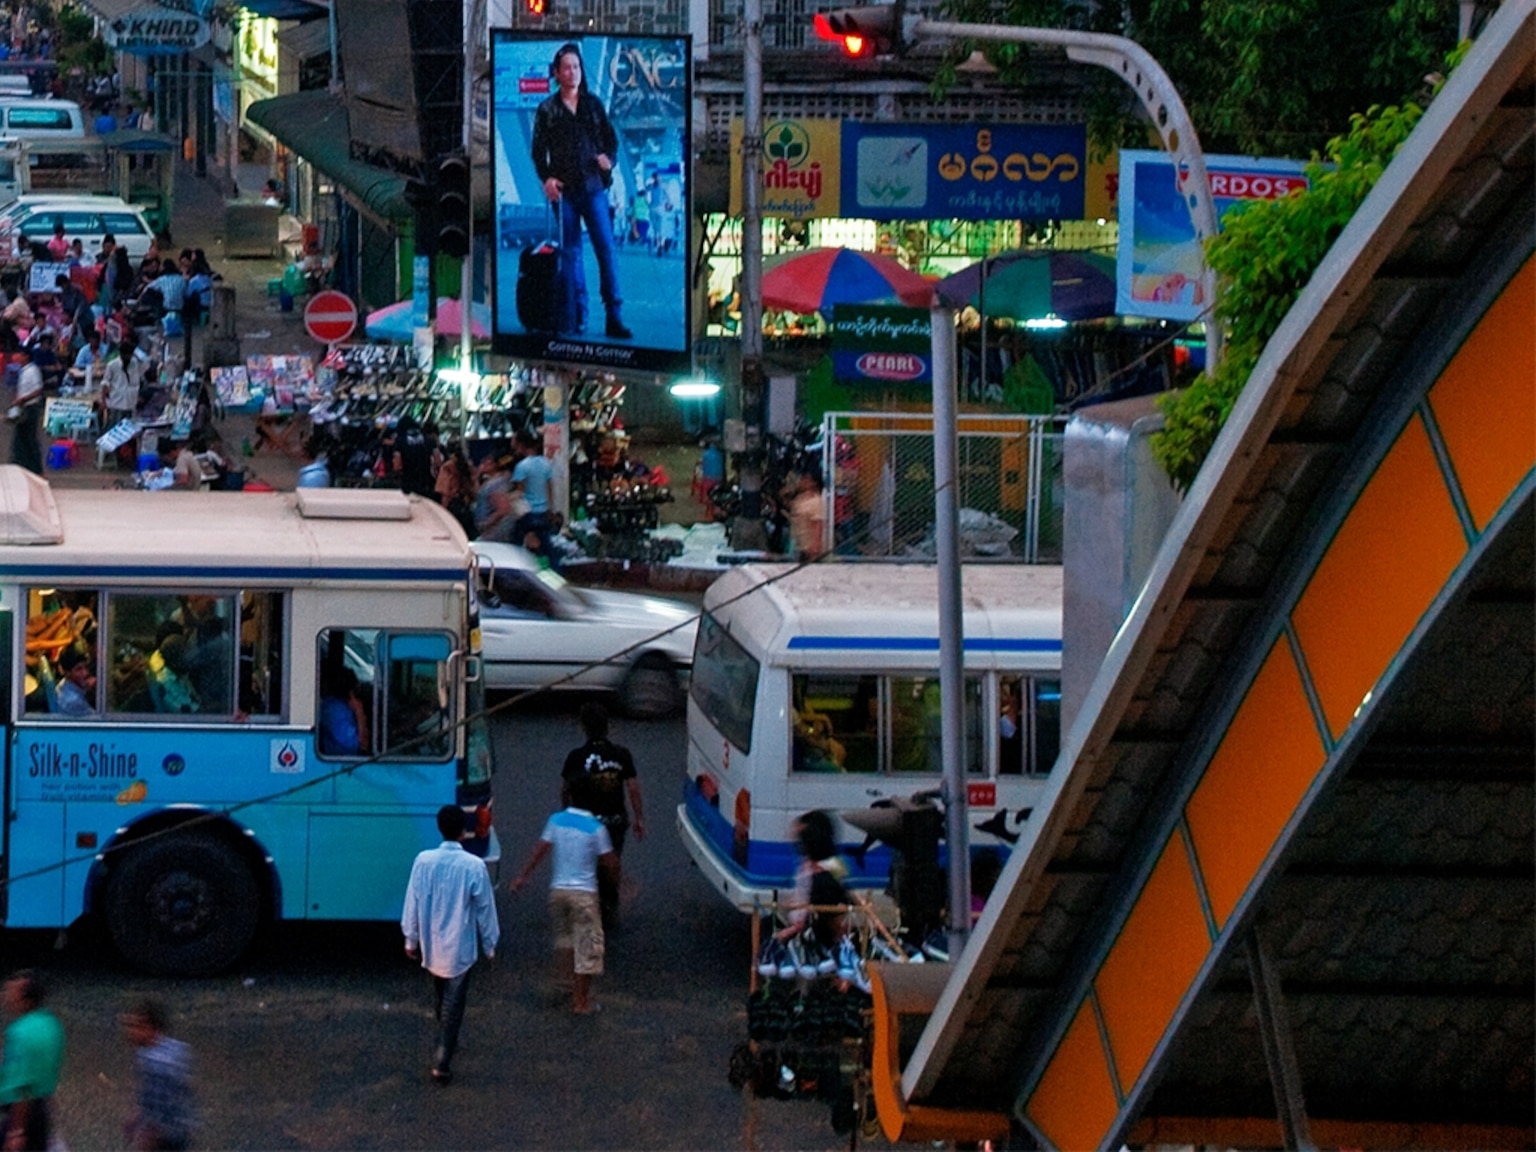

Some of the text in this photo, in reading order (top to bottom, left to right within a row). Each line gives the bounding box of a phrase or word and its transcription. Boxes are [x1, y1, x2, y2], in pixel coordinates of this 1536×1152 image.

[1211, 176, 1290, 197] RDOS
[866, 356, 915, 371] PEARL
[29, 742, 137, 778] Silk-n-Shine
